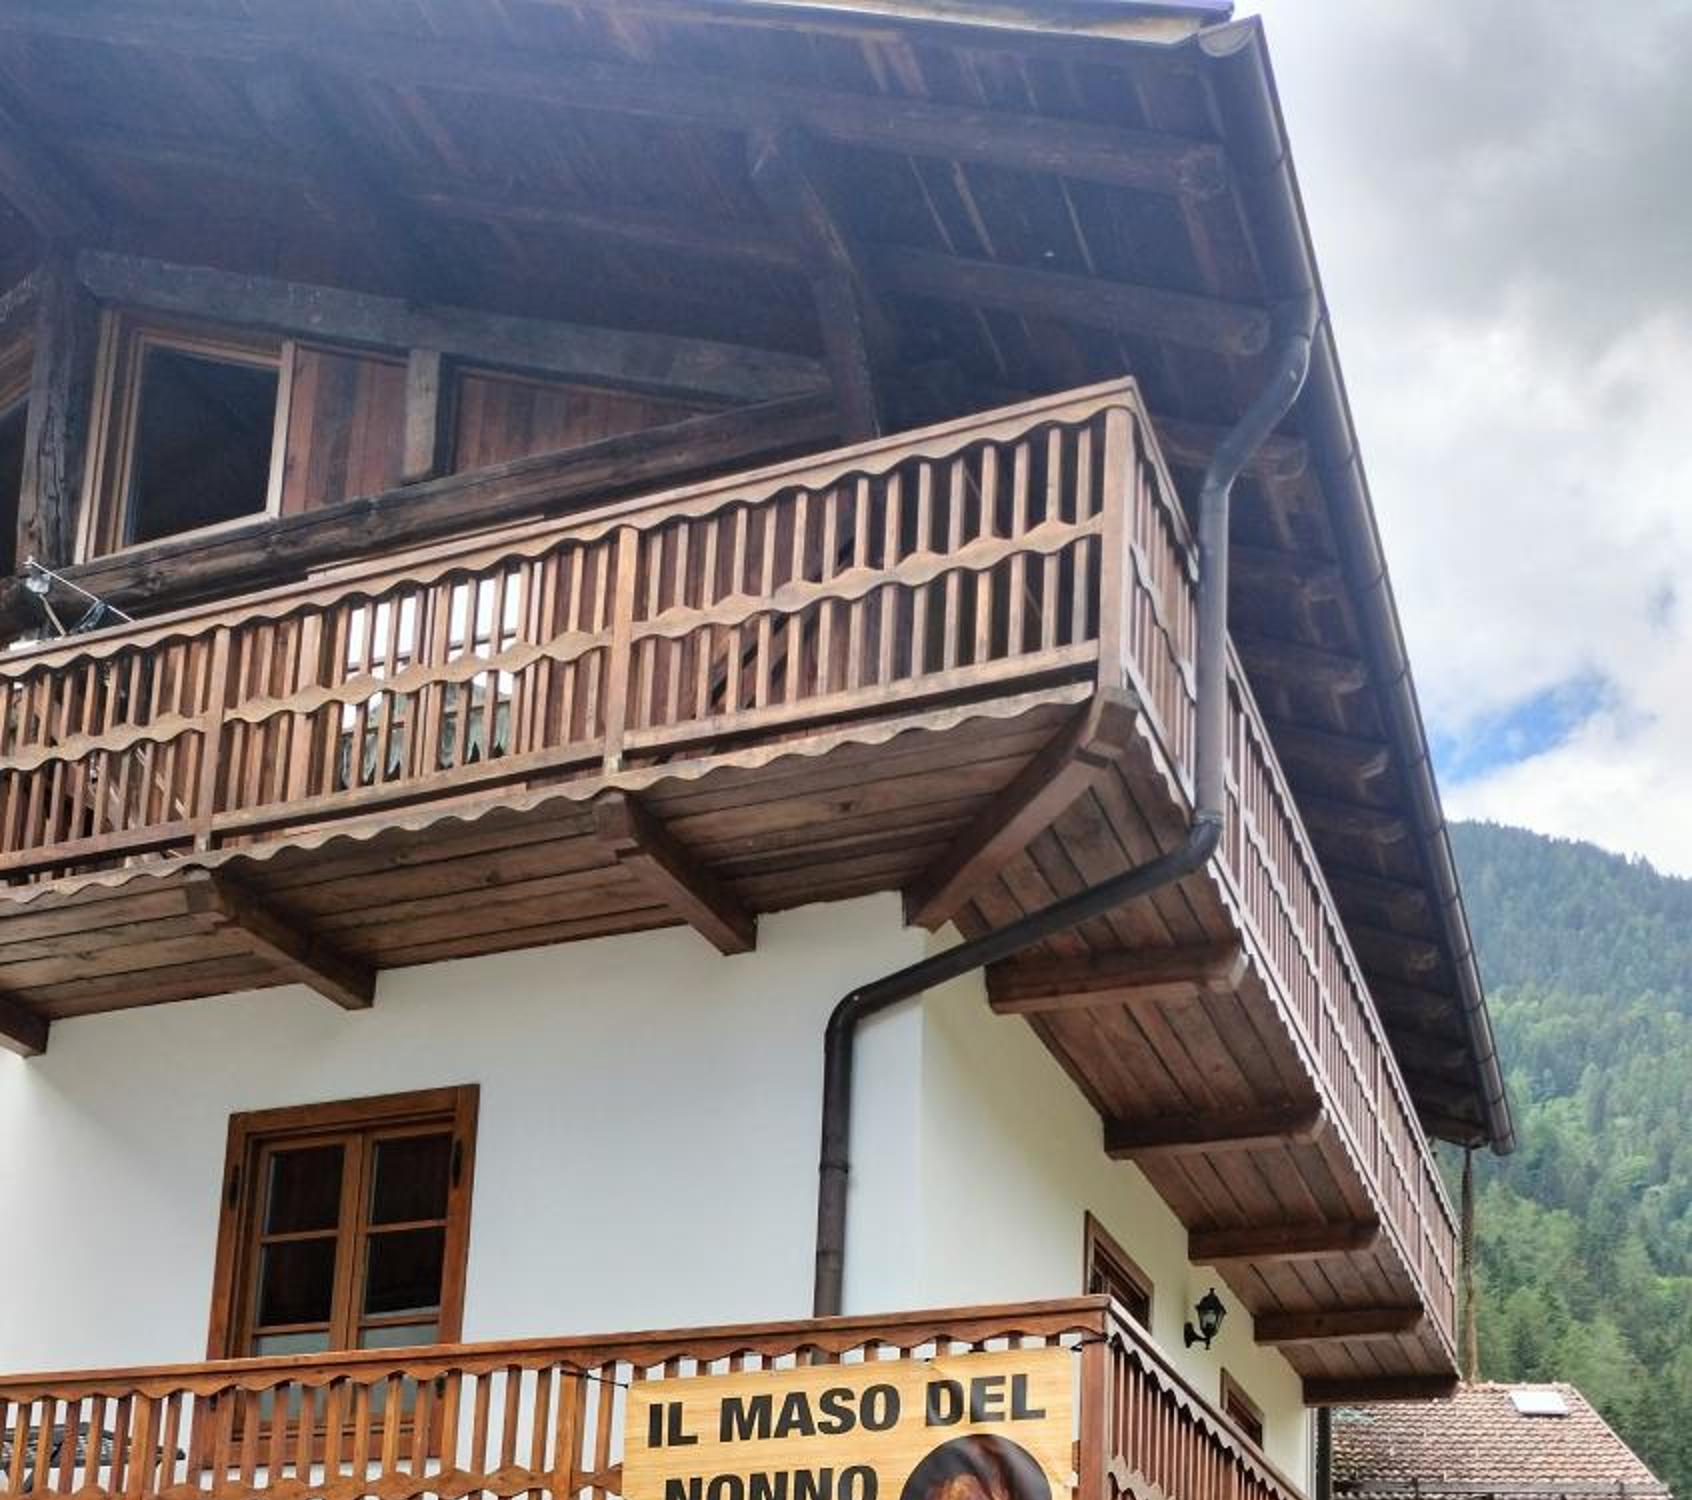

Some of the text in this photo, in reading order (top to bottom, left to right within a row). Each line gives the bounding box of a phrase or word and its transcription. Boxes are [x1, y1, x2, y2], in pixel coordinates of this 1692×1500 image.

[647, 1373, 1047, 1448] IL MASO DEL
